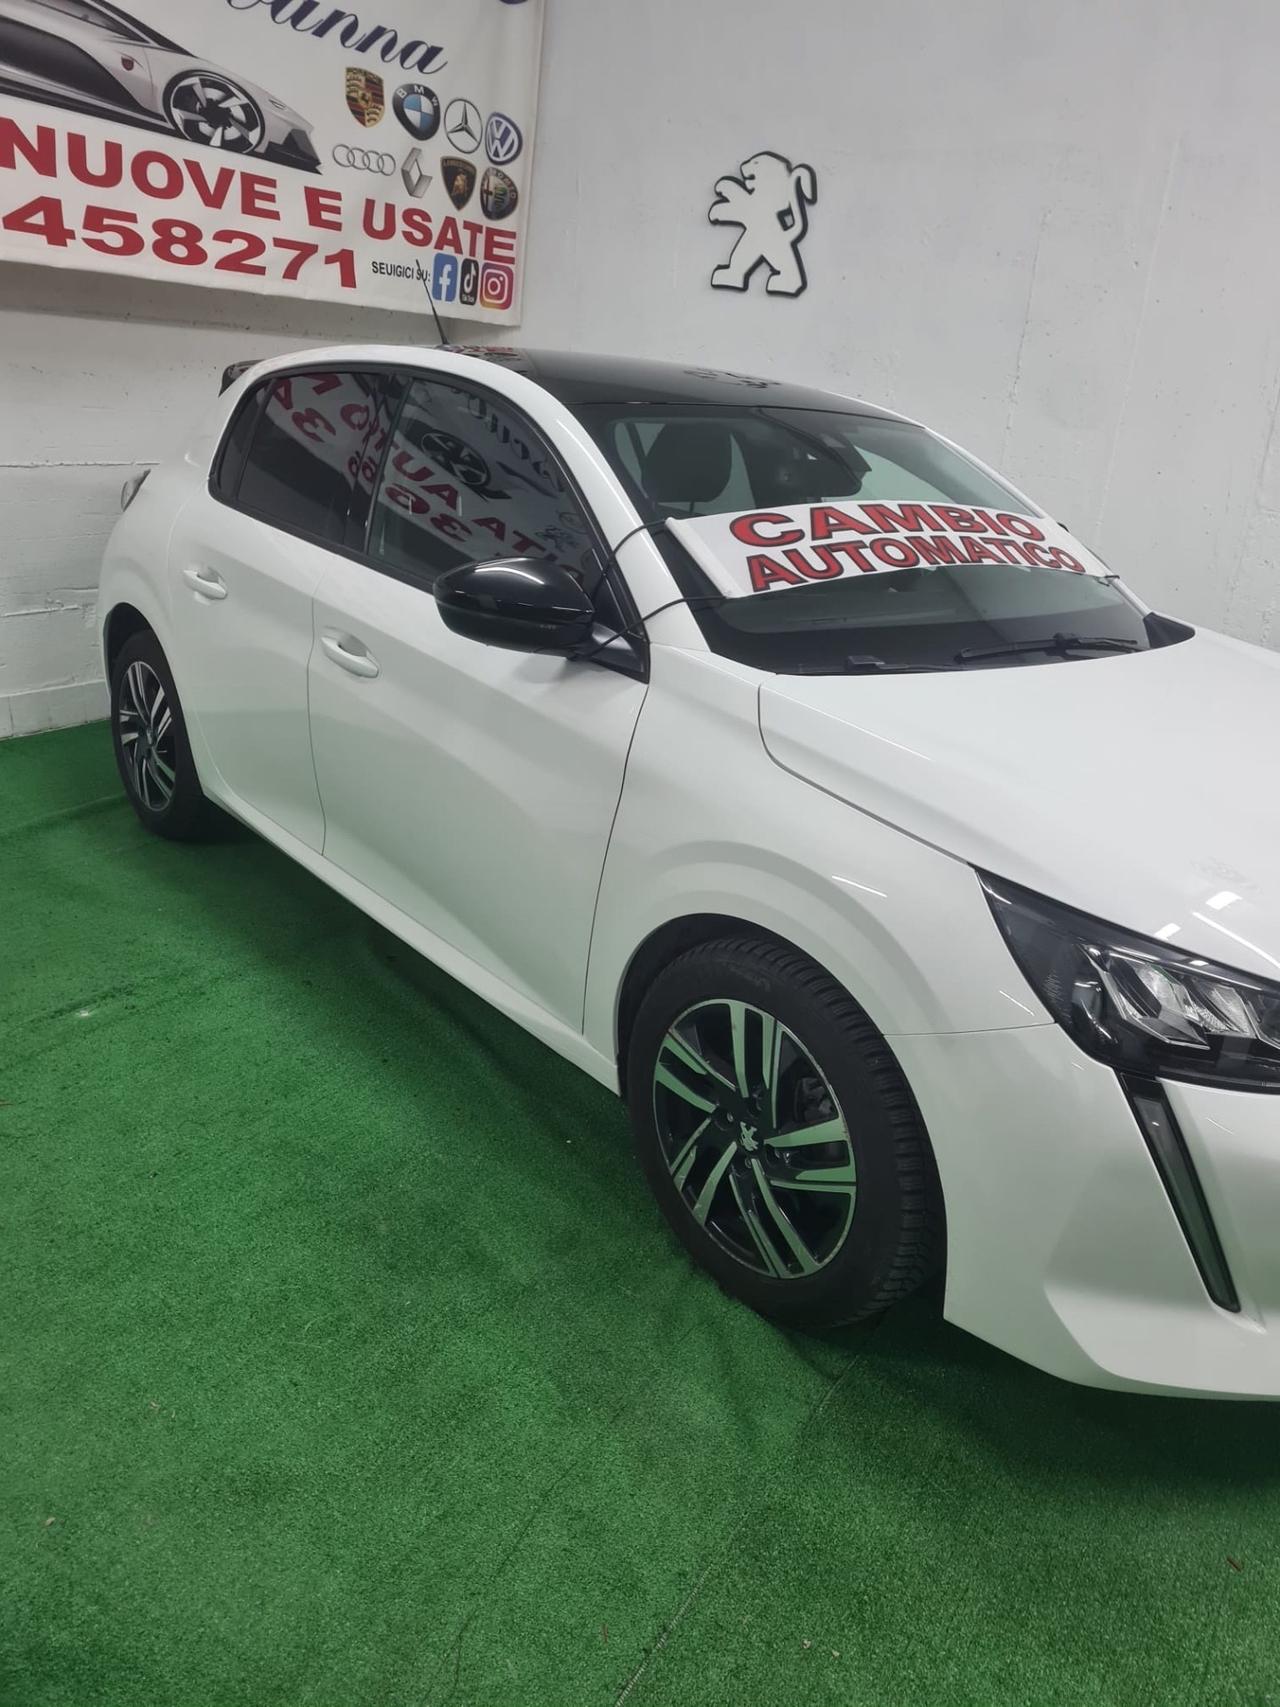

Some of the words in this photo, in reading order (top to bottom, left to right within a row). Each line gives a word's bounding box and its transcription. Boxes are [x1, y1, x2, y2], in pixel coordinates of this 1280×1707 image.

[226, 0, 448, 74] anna
[396, 84, 439, 107] BMW
[0, 117, 280, 221] NUOVE
[304, 186, 343, 231] E
[362, 198, 517, 265] USATE
[1, 196, 357, 288] 458271
[371, 261, 414, 280] SEUIGICI
[416, 268, 431, 282] SU:
[729, 503, 1046, 547] CAMBIO
[745, 535, 1086, 592] AUTOMATICO
